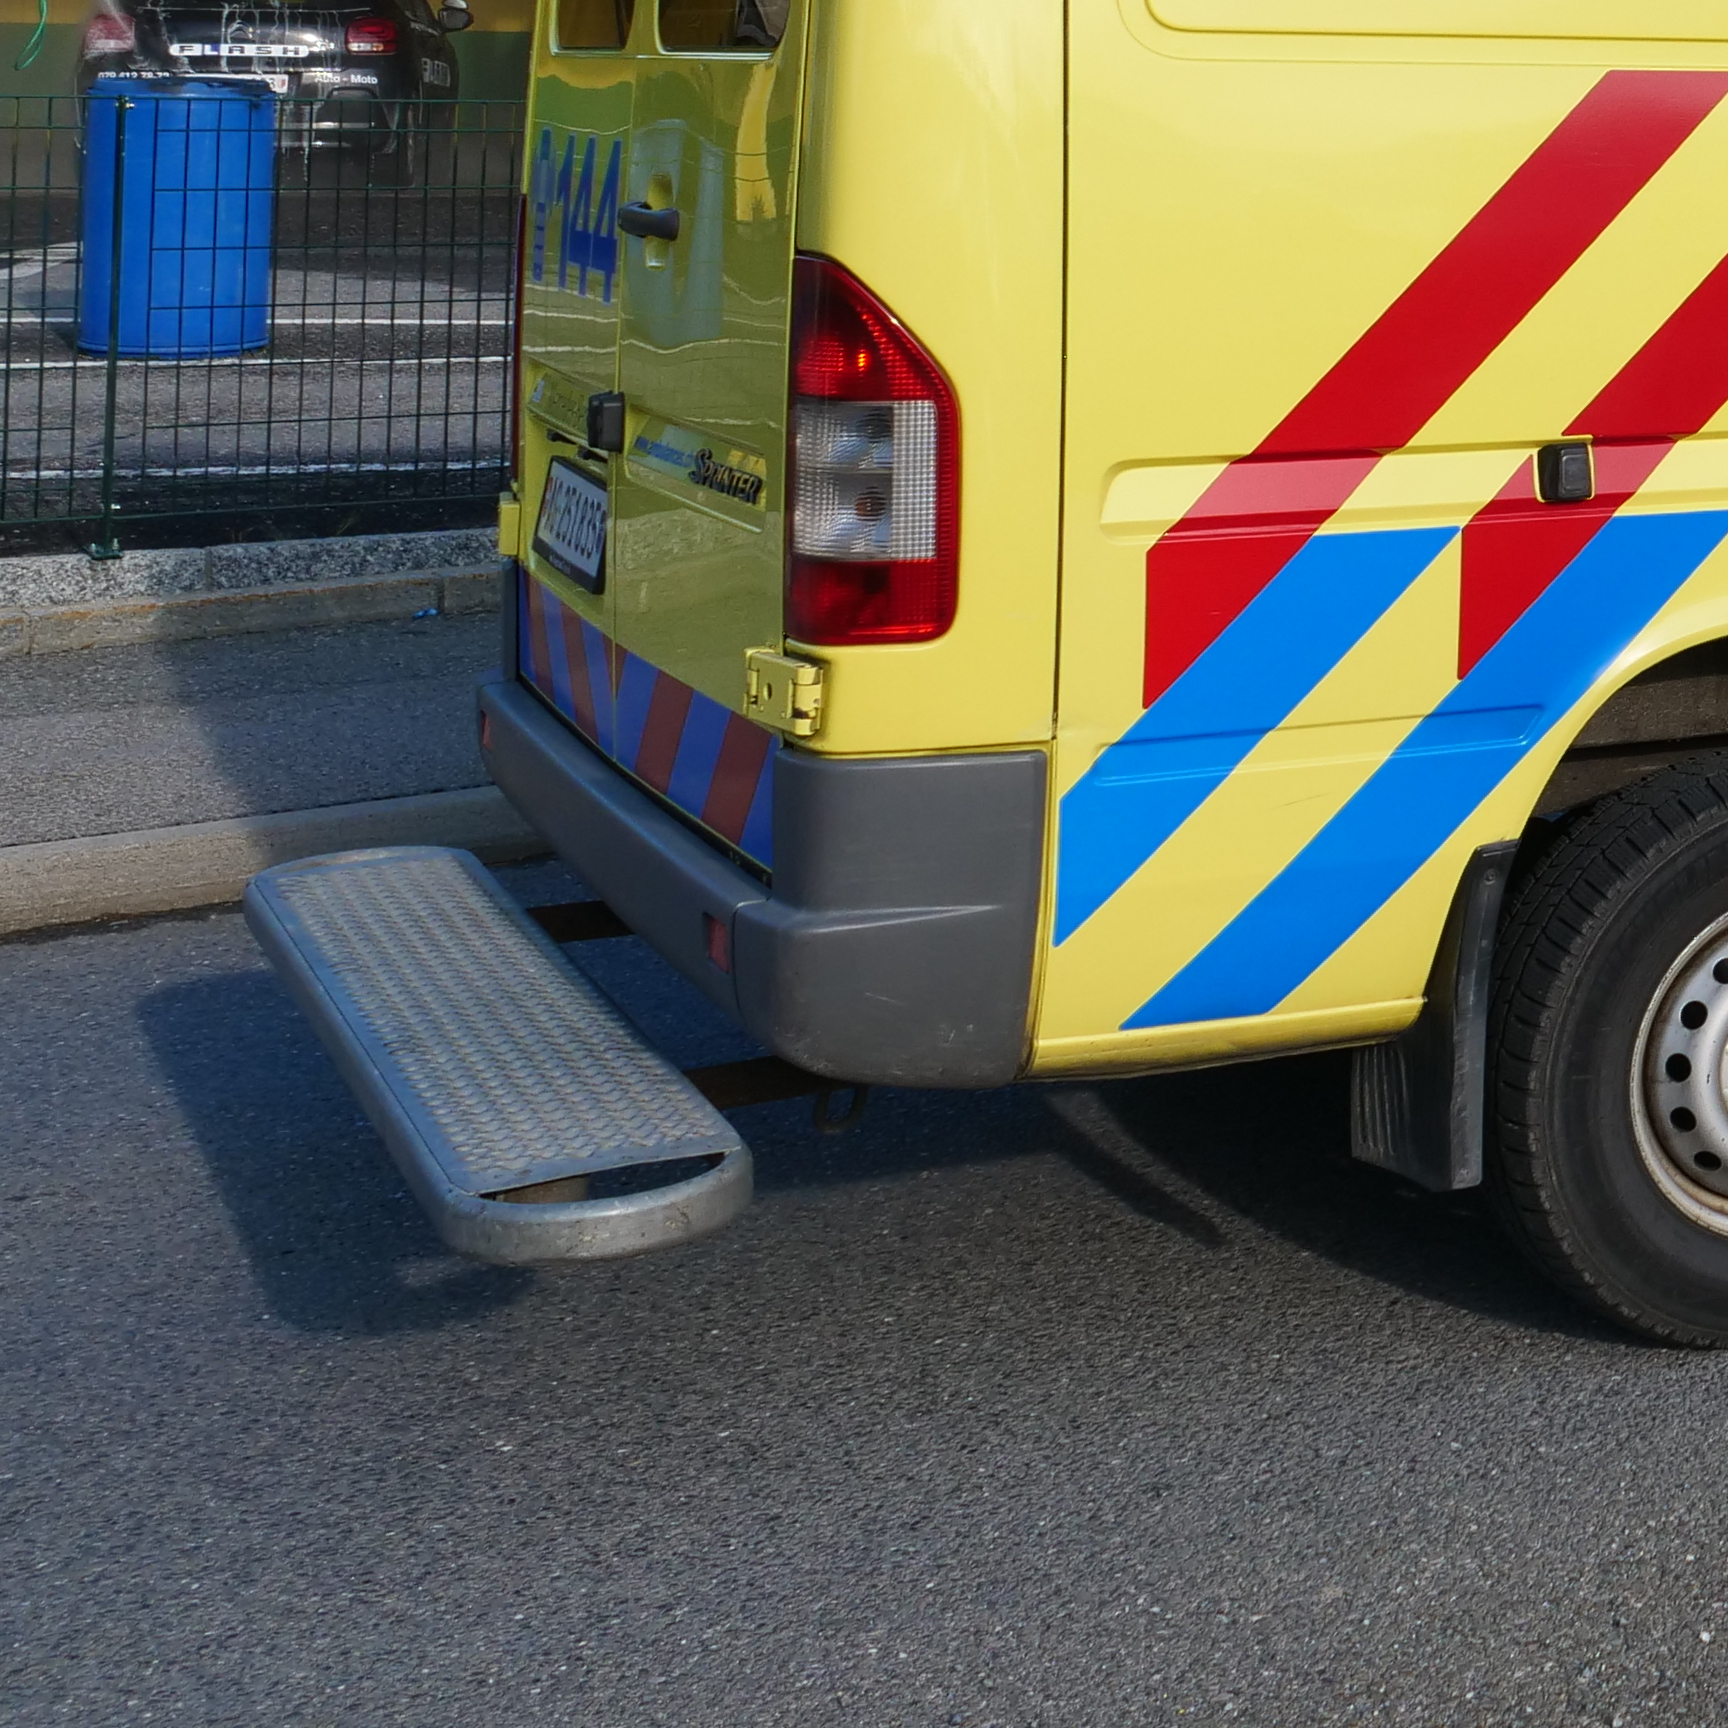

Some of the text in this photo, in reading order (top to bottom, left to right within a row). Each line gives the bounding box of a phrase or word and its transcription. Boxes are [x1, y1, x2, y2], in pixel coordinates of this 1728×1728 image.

[178, 45, 300, 57] FLASH
[315, 73, 341, 83] Auto
[351, 73, 379, 84] Moto
[556, 133, 623, 305] 144
[688, 448, 764, 505] SPRINTER
